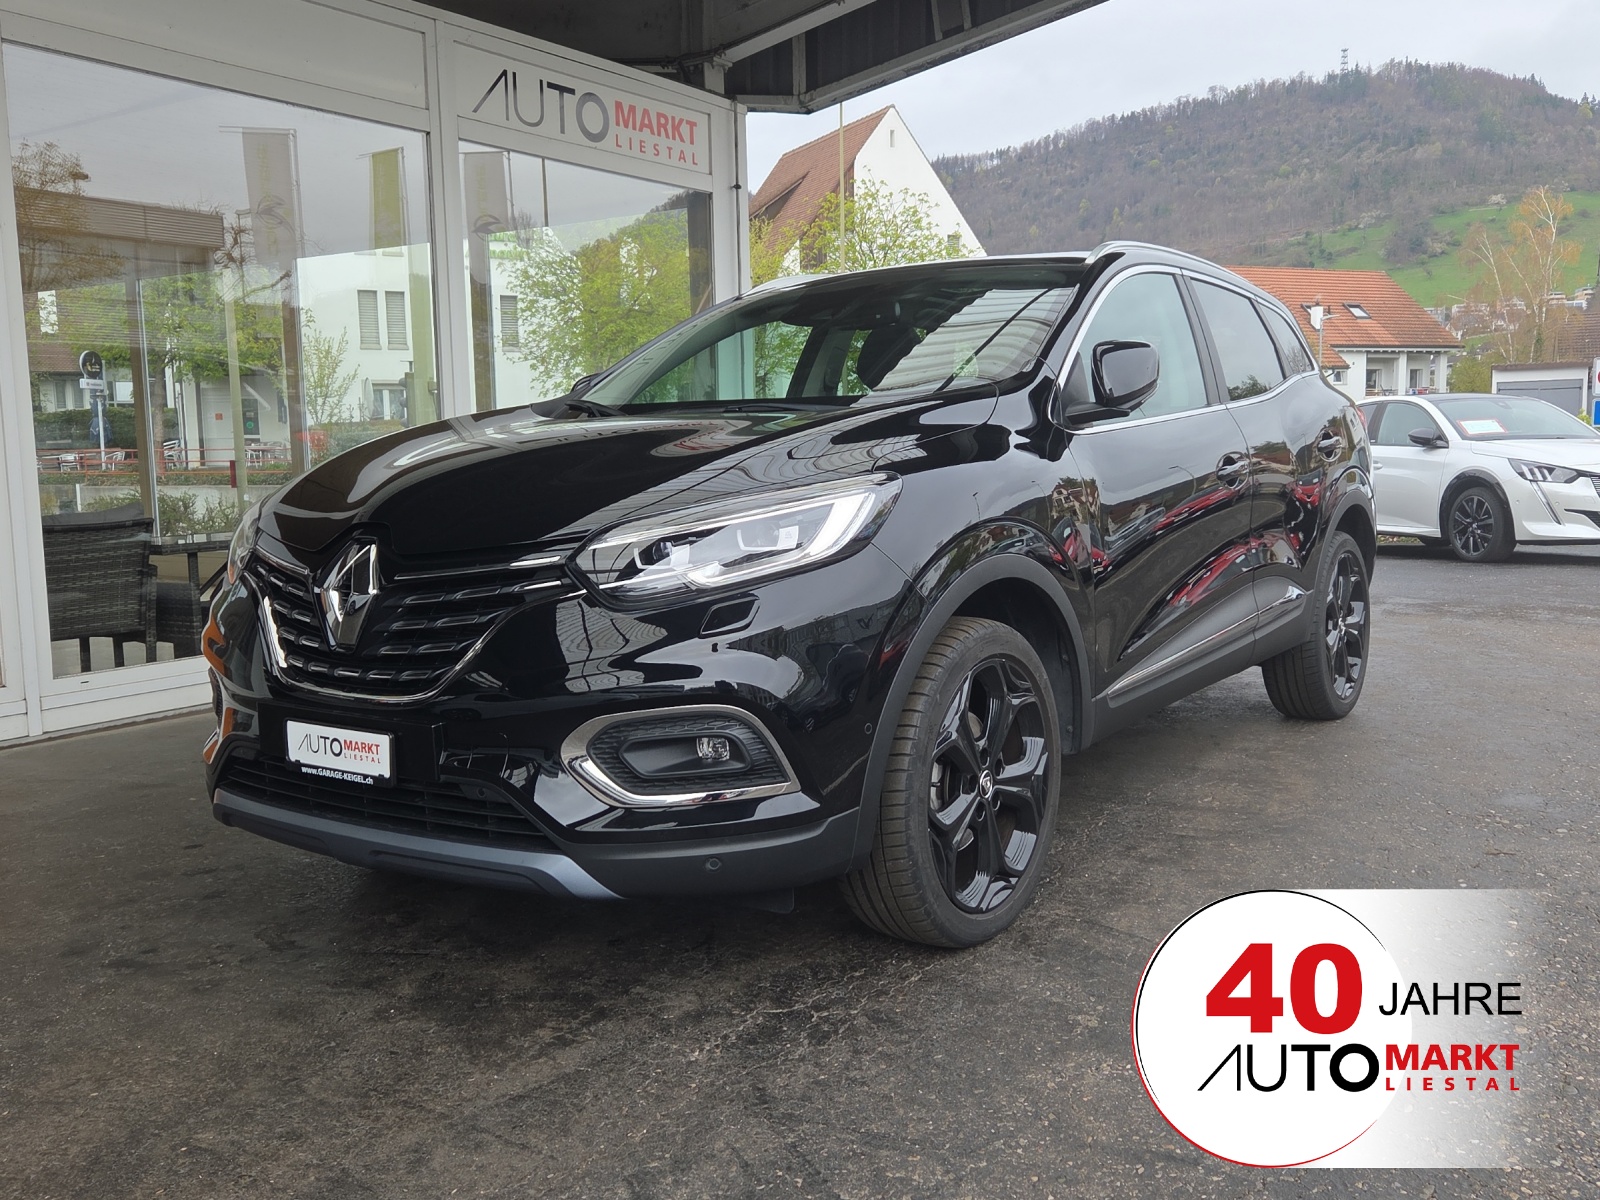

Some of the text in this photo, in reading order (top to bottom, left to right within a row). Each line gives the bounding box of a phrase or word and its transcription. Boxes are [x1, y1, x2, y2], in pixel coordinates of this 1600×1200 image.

[472, 69, 697, 145] AUTO MARKT
[615, 133, 698, 166] LIESTAL
[298, 733, 380, 757] AUTO MARKT
[344, 753, 381, 764] LIESTAL
[301, 766, 374, 785] www.GARAGE-KEIGEL.ch
